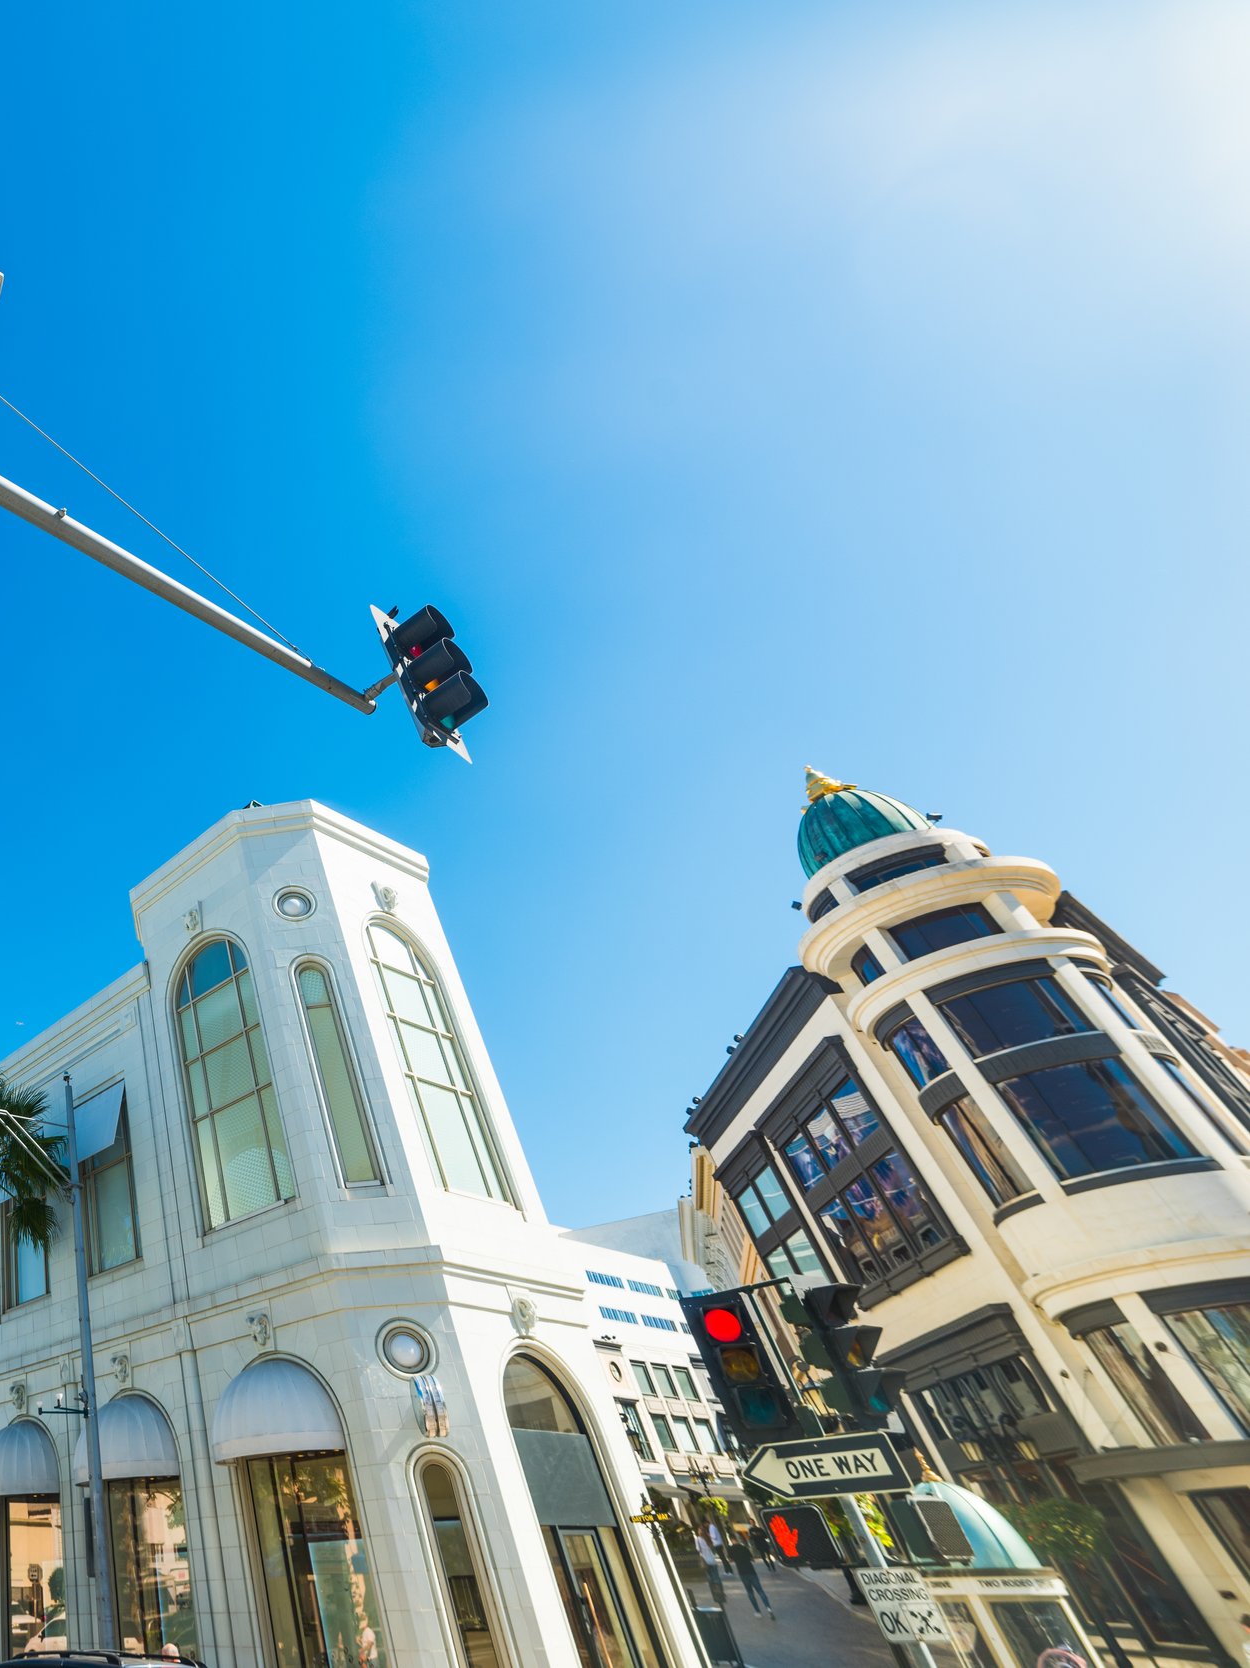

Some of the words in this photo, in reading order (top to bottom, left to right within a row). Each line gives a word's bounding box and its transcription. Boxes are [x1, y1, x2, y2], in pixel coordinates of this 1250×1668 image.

[784, 1458, 831, 1480] ONE
[832, 1452, 878, 1475] WAY
[860, 1570, 919, 1586] DIAGONAL
[976, 1579, 1001, 1588] TWO
[866, 1587, 930, 1601] CROSSING
[878, 1610, 910, 1635] OK
